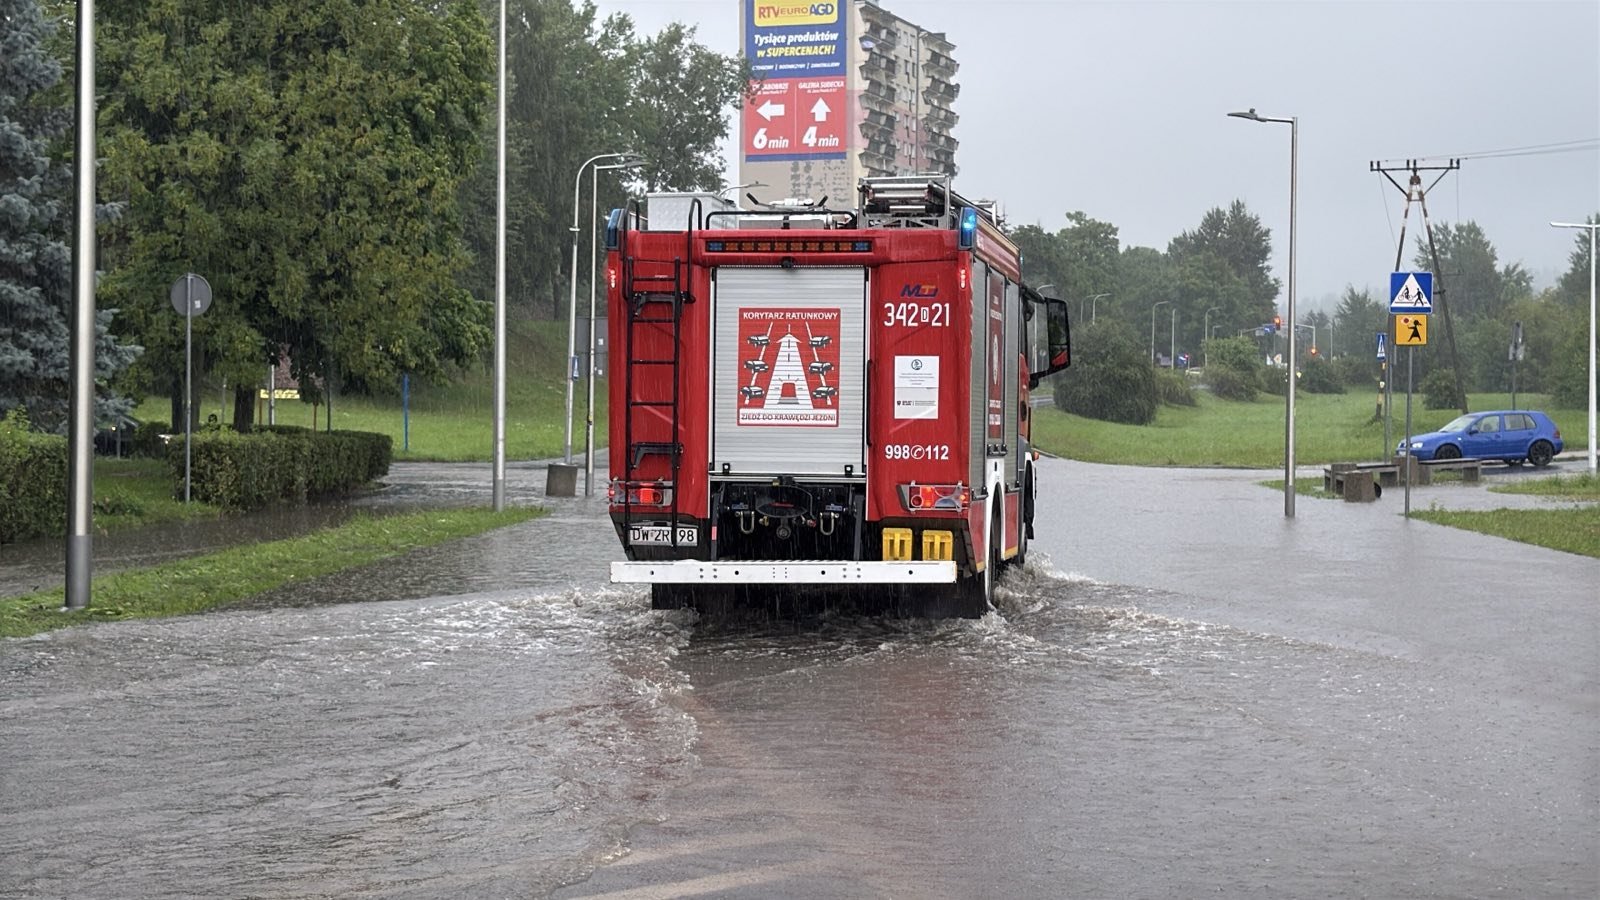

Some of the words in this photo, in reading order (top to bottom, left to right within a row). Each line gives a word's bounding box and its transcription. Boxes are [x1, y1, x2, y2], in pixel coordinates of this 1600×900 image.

[758, 6, 780, 19] RTV
[780, 7, 808, 15] EURO
[809, 3, 834, 16] AGD
[754, 33, 786, 46] Tysiące
[787, 31, 839, 45] produktów
[753, 128, 767, 149] 6
[768, 136, 789, 149] min
[802, 126, 817, 147] 4
[818, 134, 839, 147] min
[743, 311, 785, 320] KORYTARZ
[785, 312, 838, 320] RATUNKOWY
[885, 444, 910, 460] 998
[925, 444, 949, 460] 112
[632, 529, 649, 541] DW
